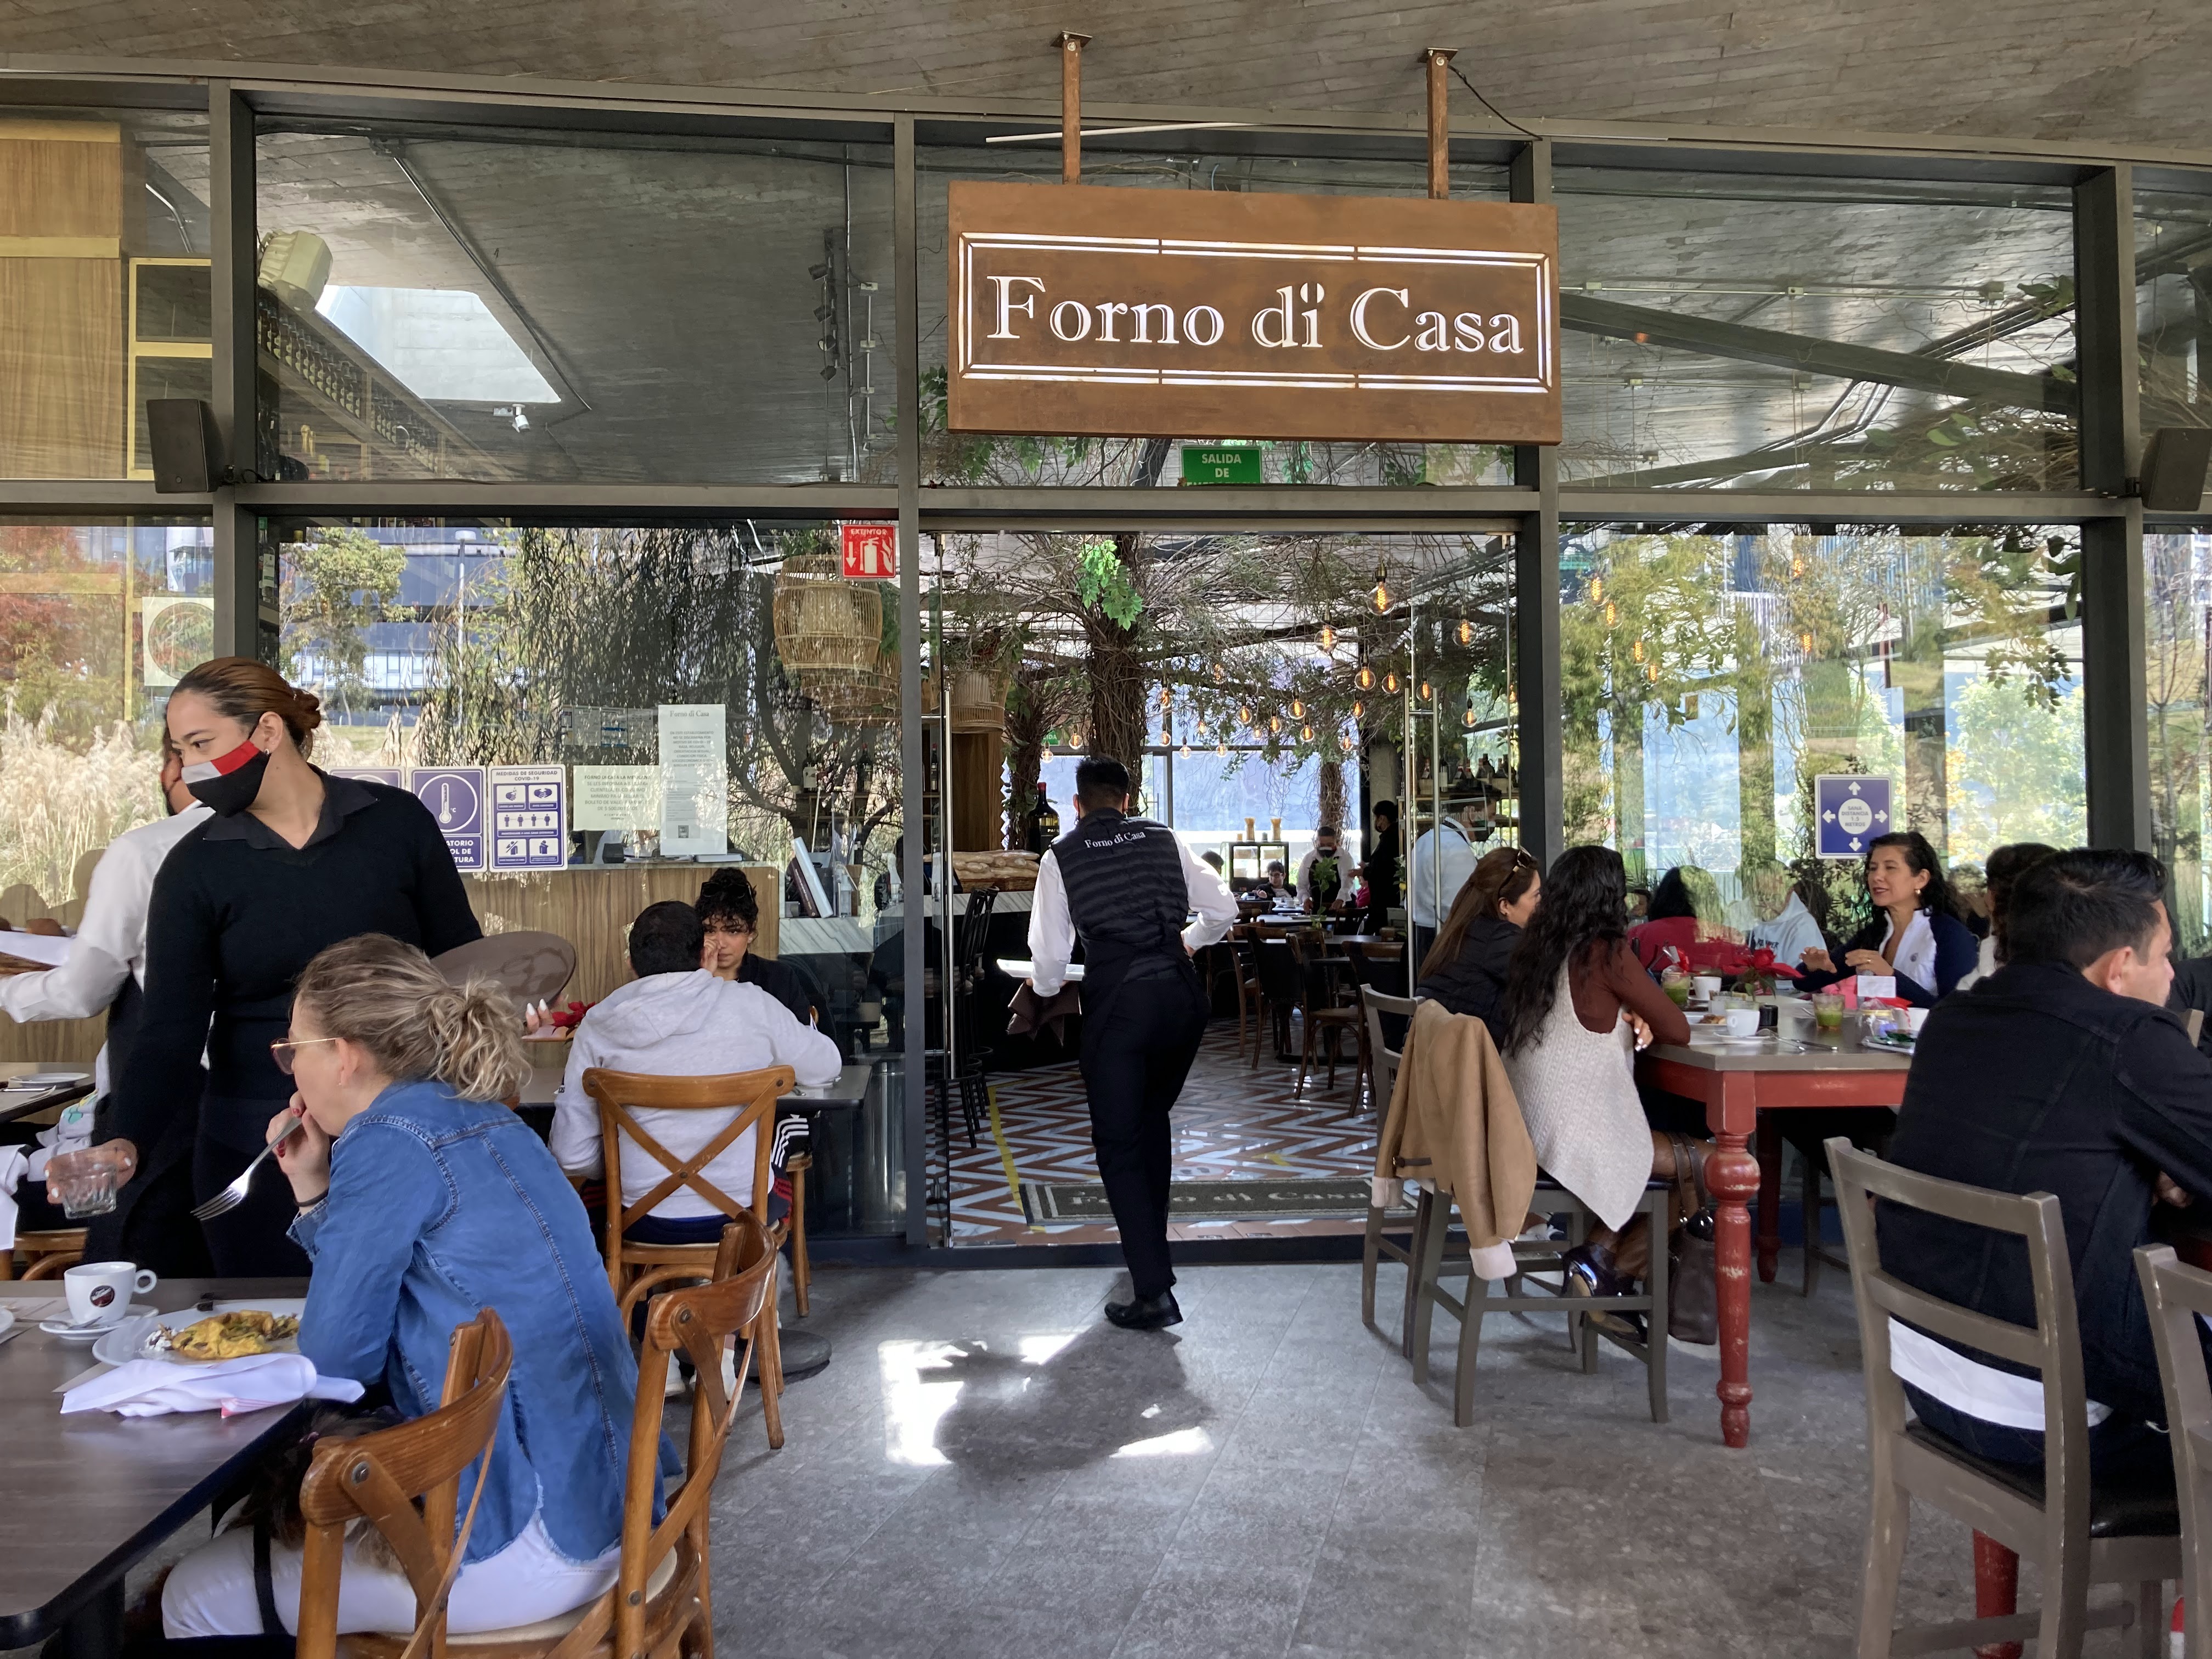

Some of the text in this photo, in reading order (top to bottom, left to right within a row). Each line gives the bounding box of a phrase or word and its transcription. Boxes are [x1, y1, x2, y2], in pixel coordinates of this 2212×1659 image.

[987, 275, 1524, 354] Forno di Casa
[1201, 453, 1242, 464] SALIDA
[1215, 467, 1229, 478] DE
[1084, 832, 1146, 848] Forno di Casa
